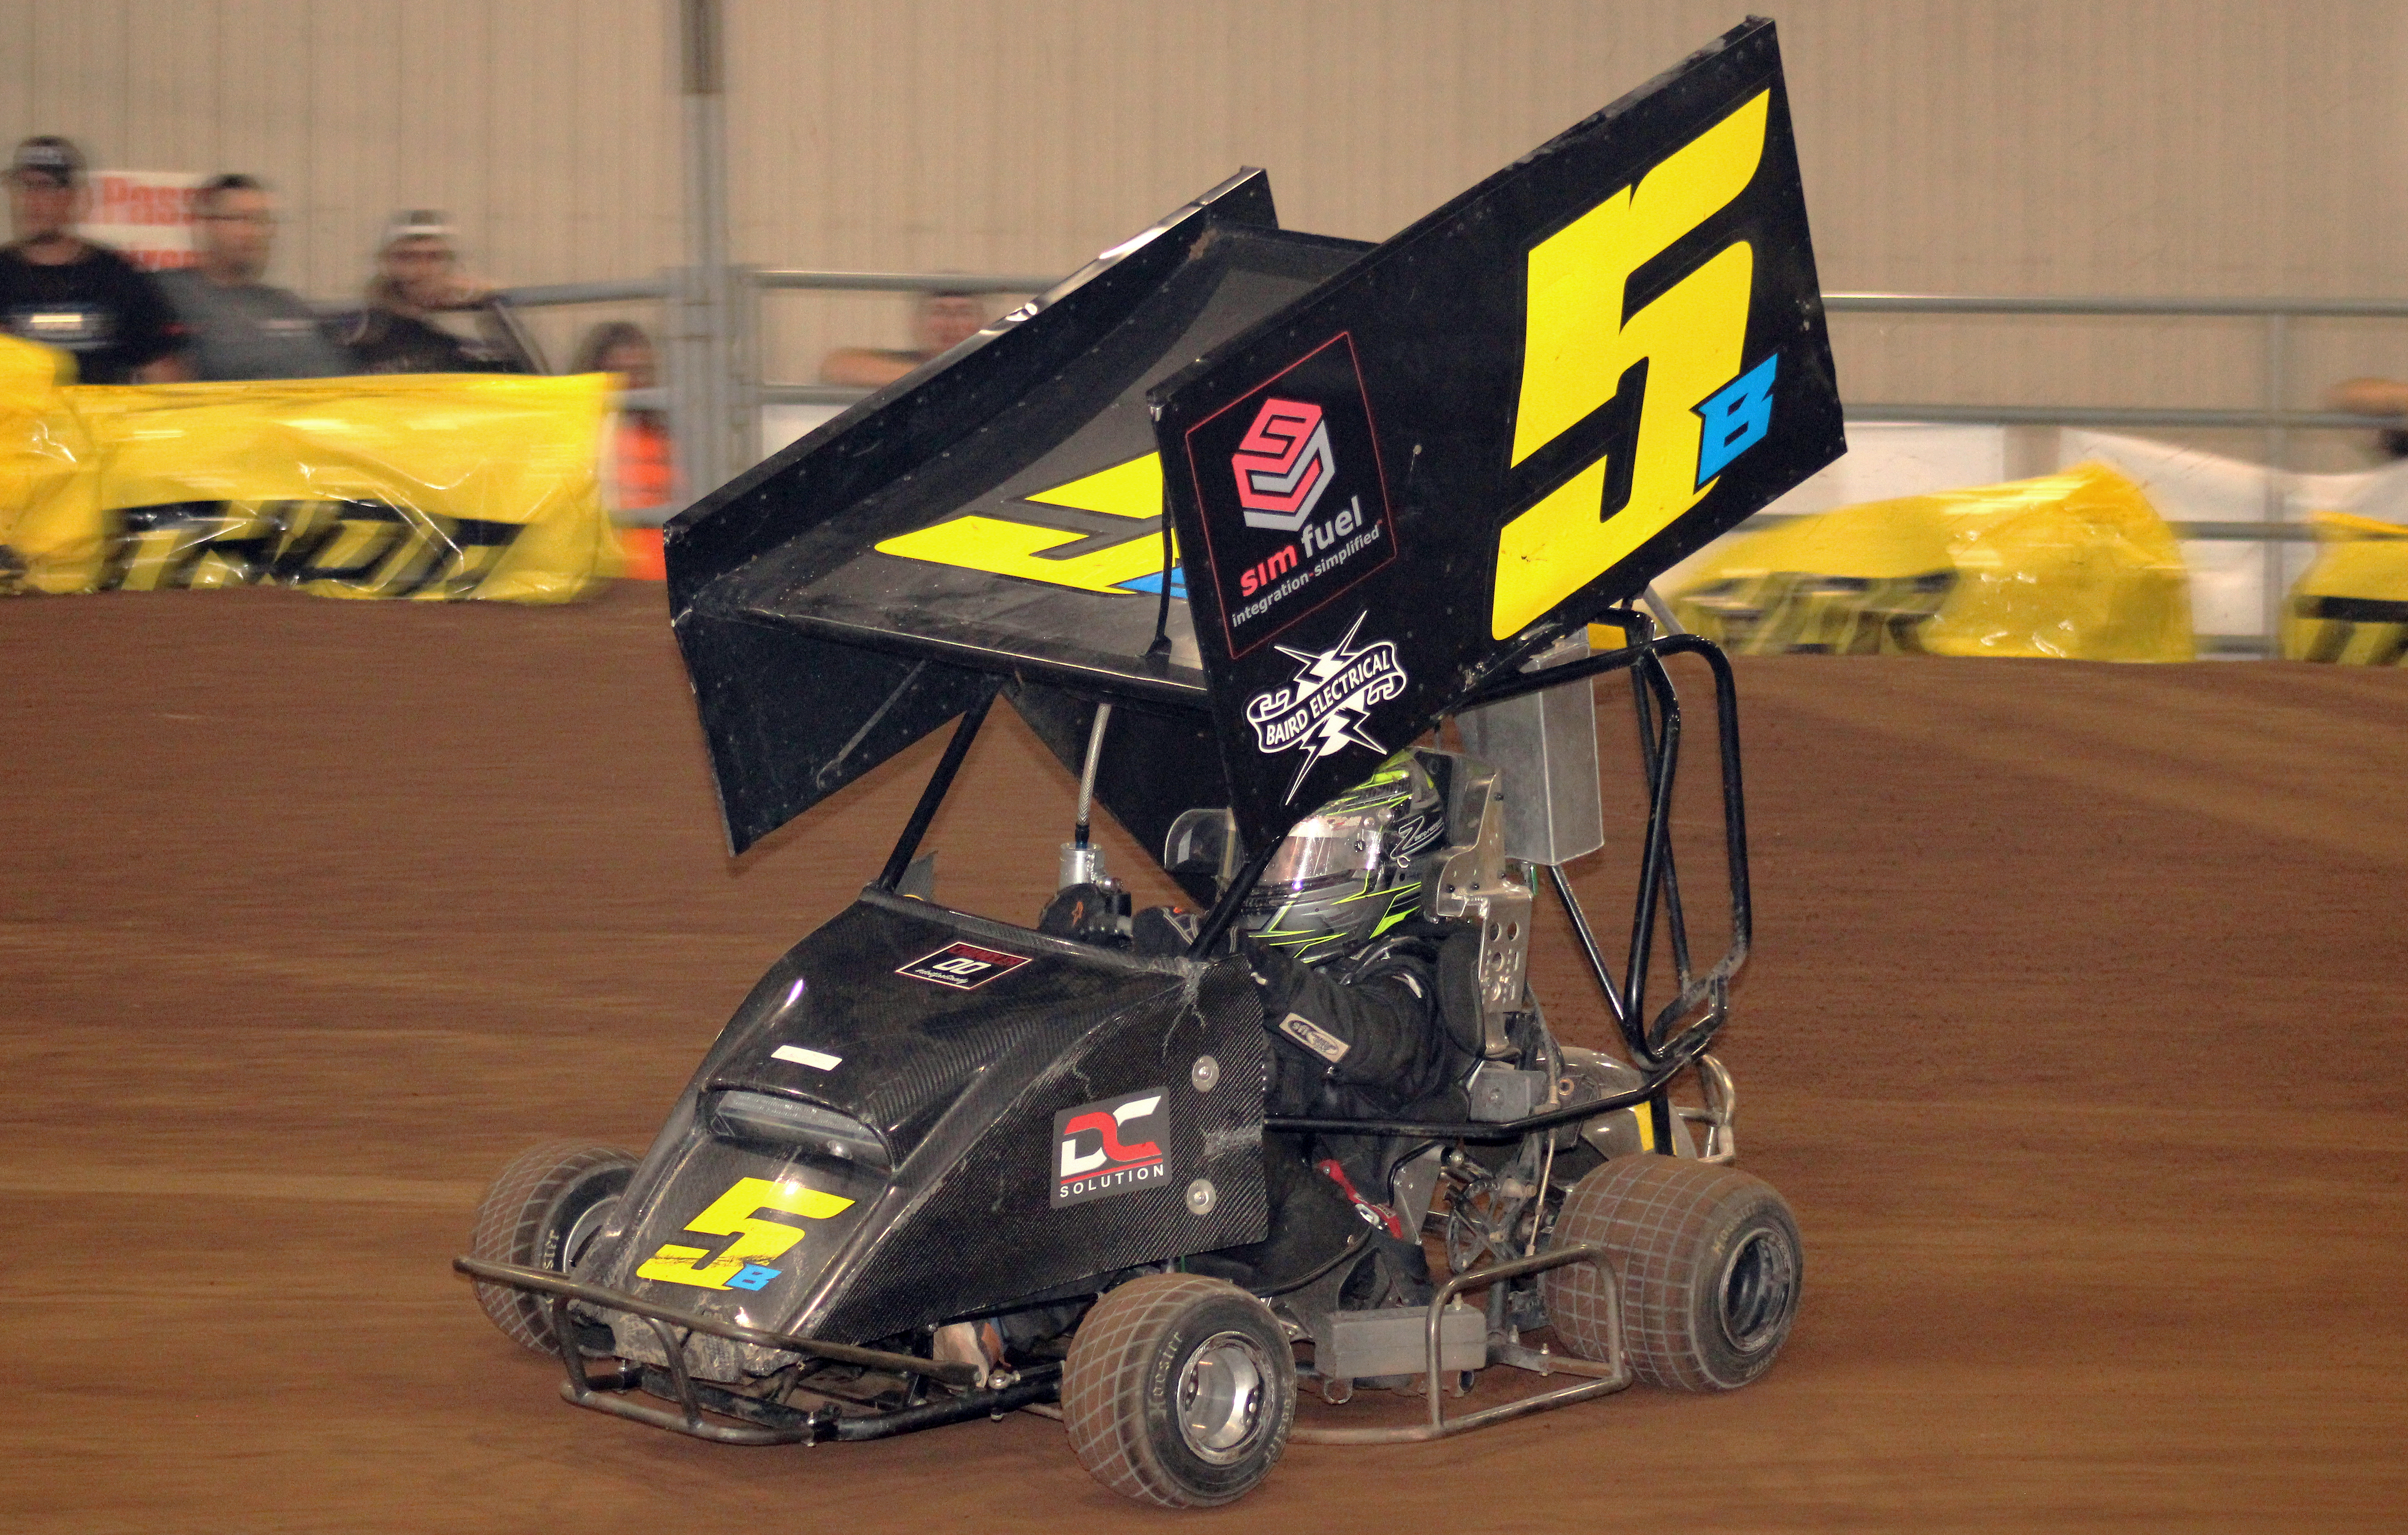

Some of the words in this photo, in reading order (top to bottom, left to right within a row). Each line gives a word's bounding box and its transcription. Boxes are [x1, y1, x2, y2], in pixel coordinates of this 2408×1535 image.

[1240, 545, 1297, 597] sim
[1301, 495, 1362, 558] fuel
[1266, 709, 1308, 746] BAIRD
[1310, 650, 1391, 719] ELECTRICAL
[1060, 1095, 1162, 1177] DC
[1060, 1164, 1164, 1198] SOLUTION
